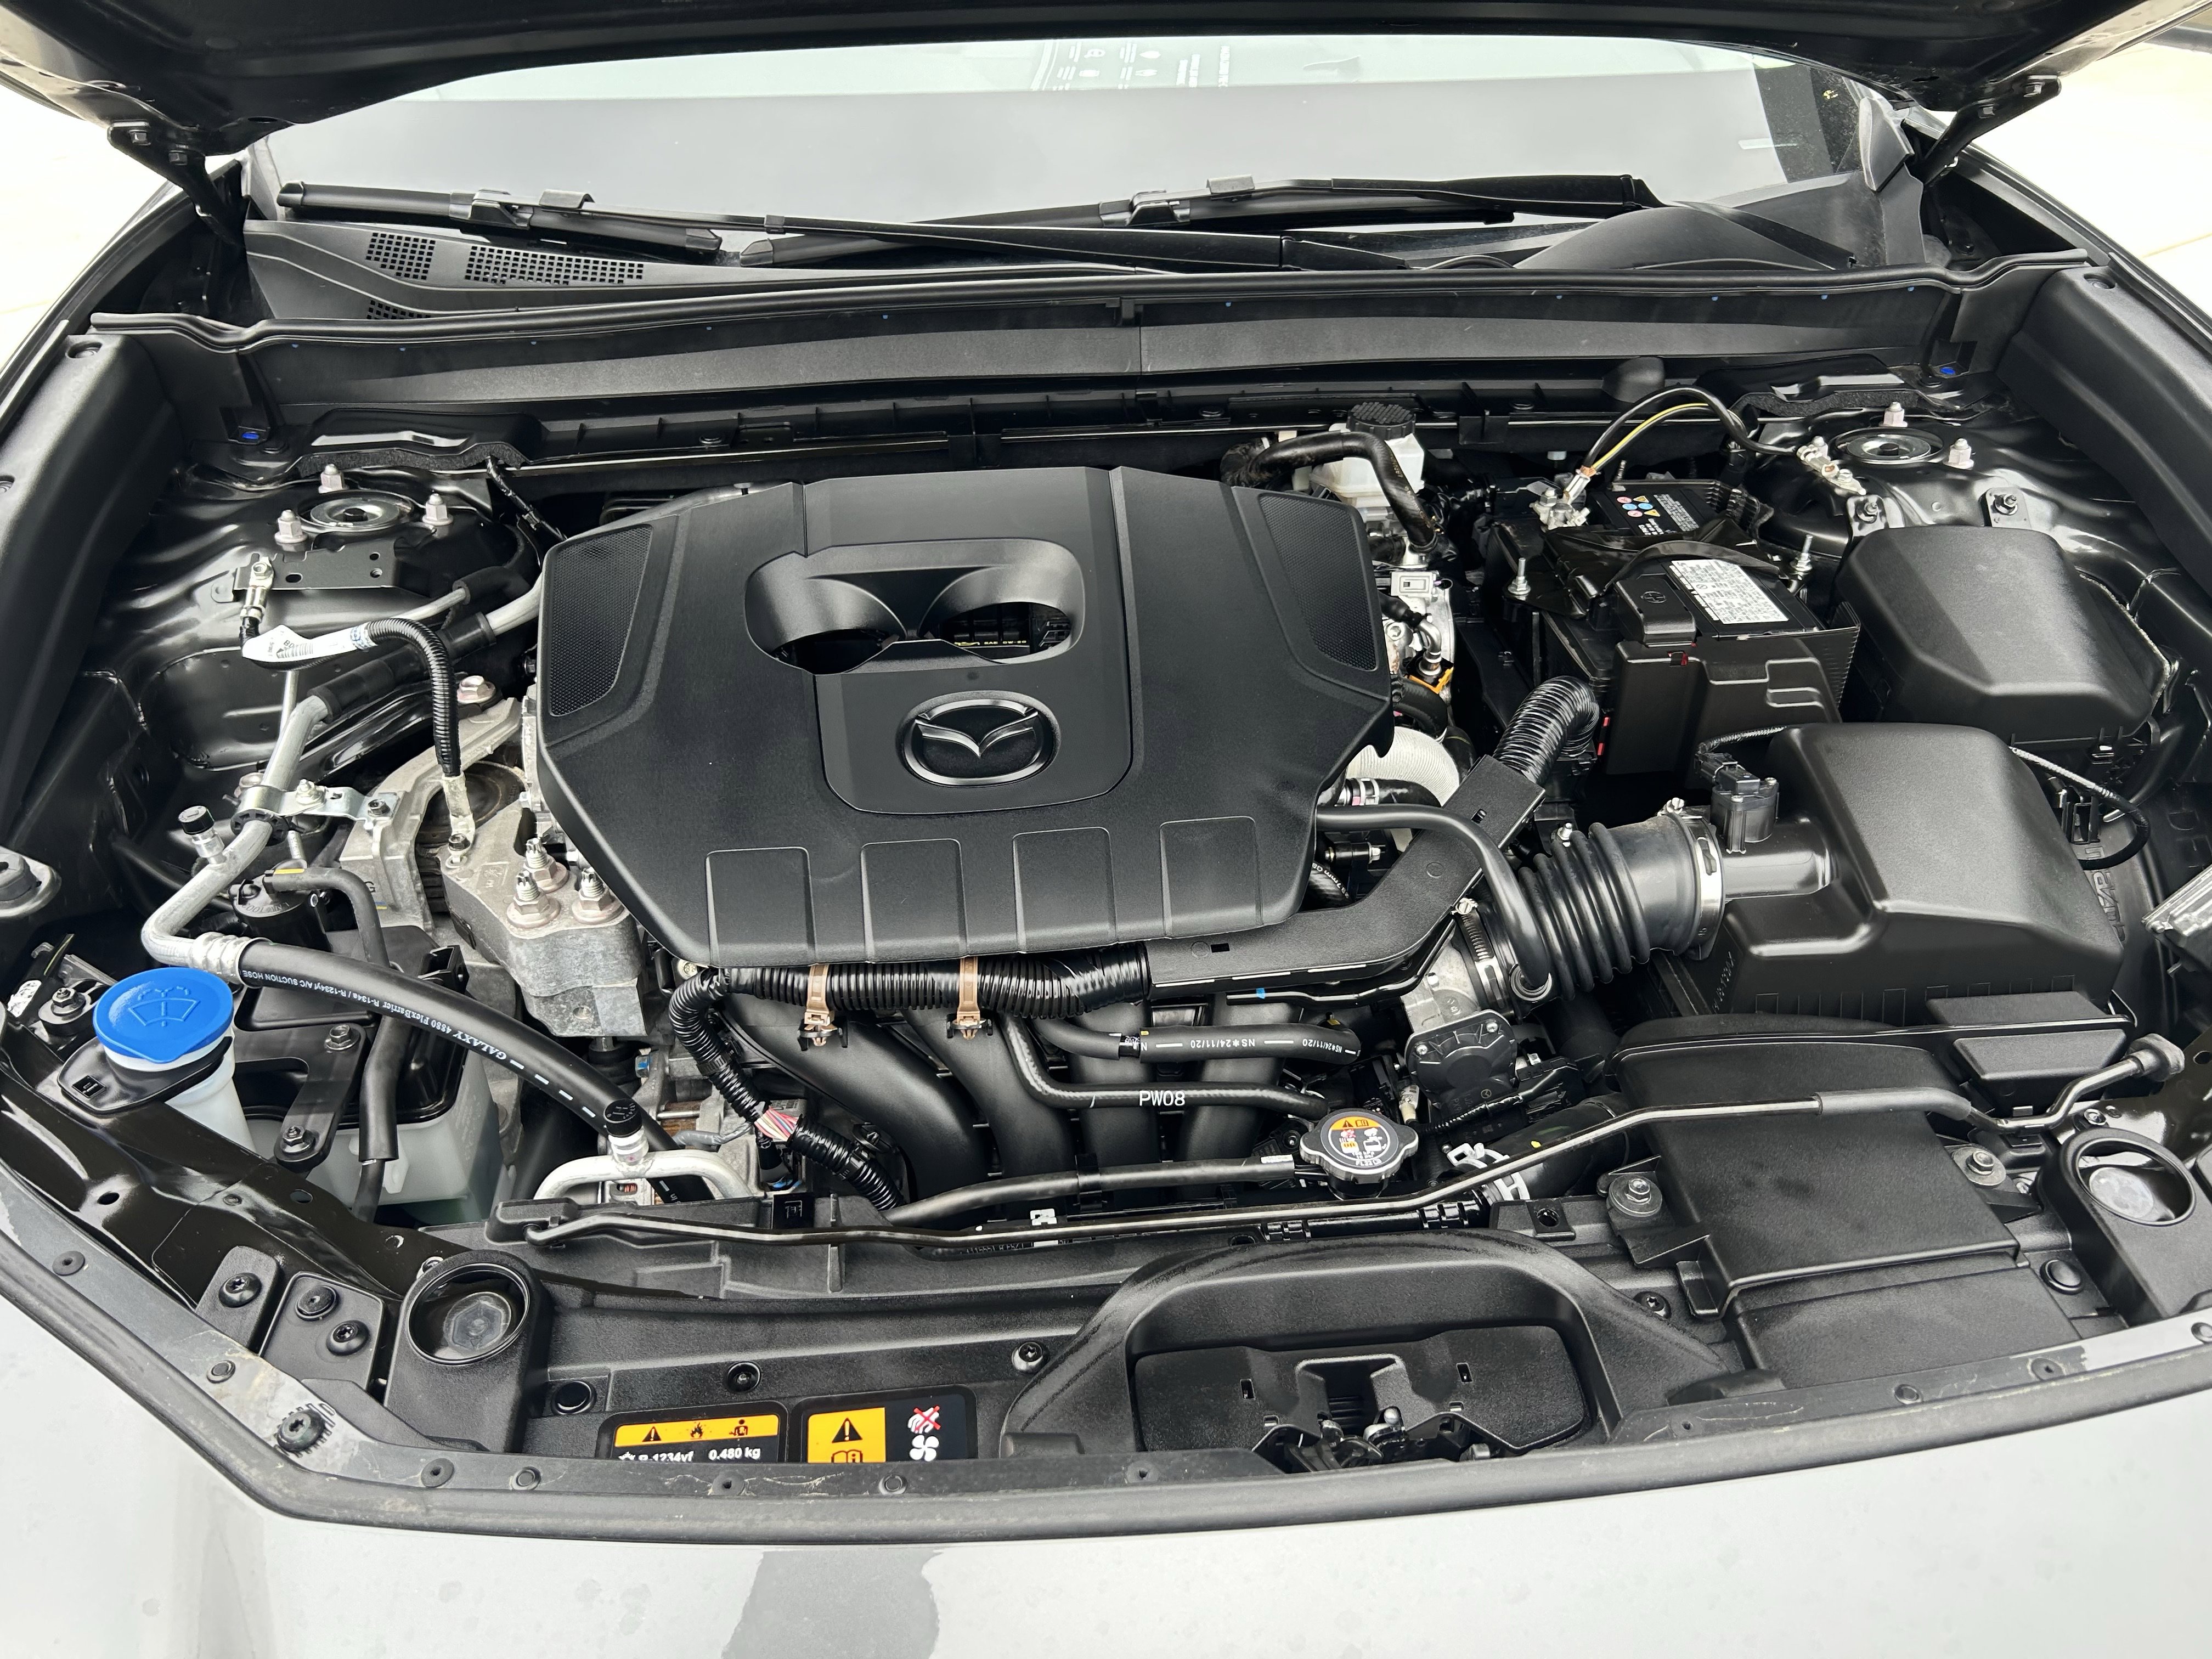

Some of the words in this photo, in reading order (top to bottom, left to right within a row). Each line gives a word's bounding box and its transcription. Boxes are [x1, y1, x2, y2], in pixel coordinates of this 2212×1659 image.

[241, 969, 264, 980] HOSE
[264, 972, 299, 986] SUCTION
[299, 979, 313, 989] A/C
[314, 981, 347, 998] R-1234yf
[352, 992, 380, 1007] R-134a
[382, 1000, 430, 1026] FlexBarrier
[431, 1018, 453, 1035] 4880
[452, 1029, 507, 1061] GALAXY
[1139, 1090, 1186, 1108] PW08
[708, 1447, 742, 1460] 0.480
[744, 1446, 761, 1459] kg
